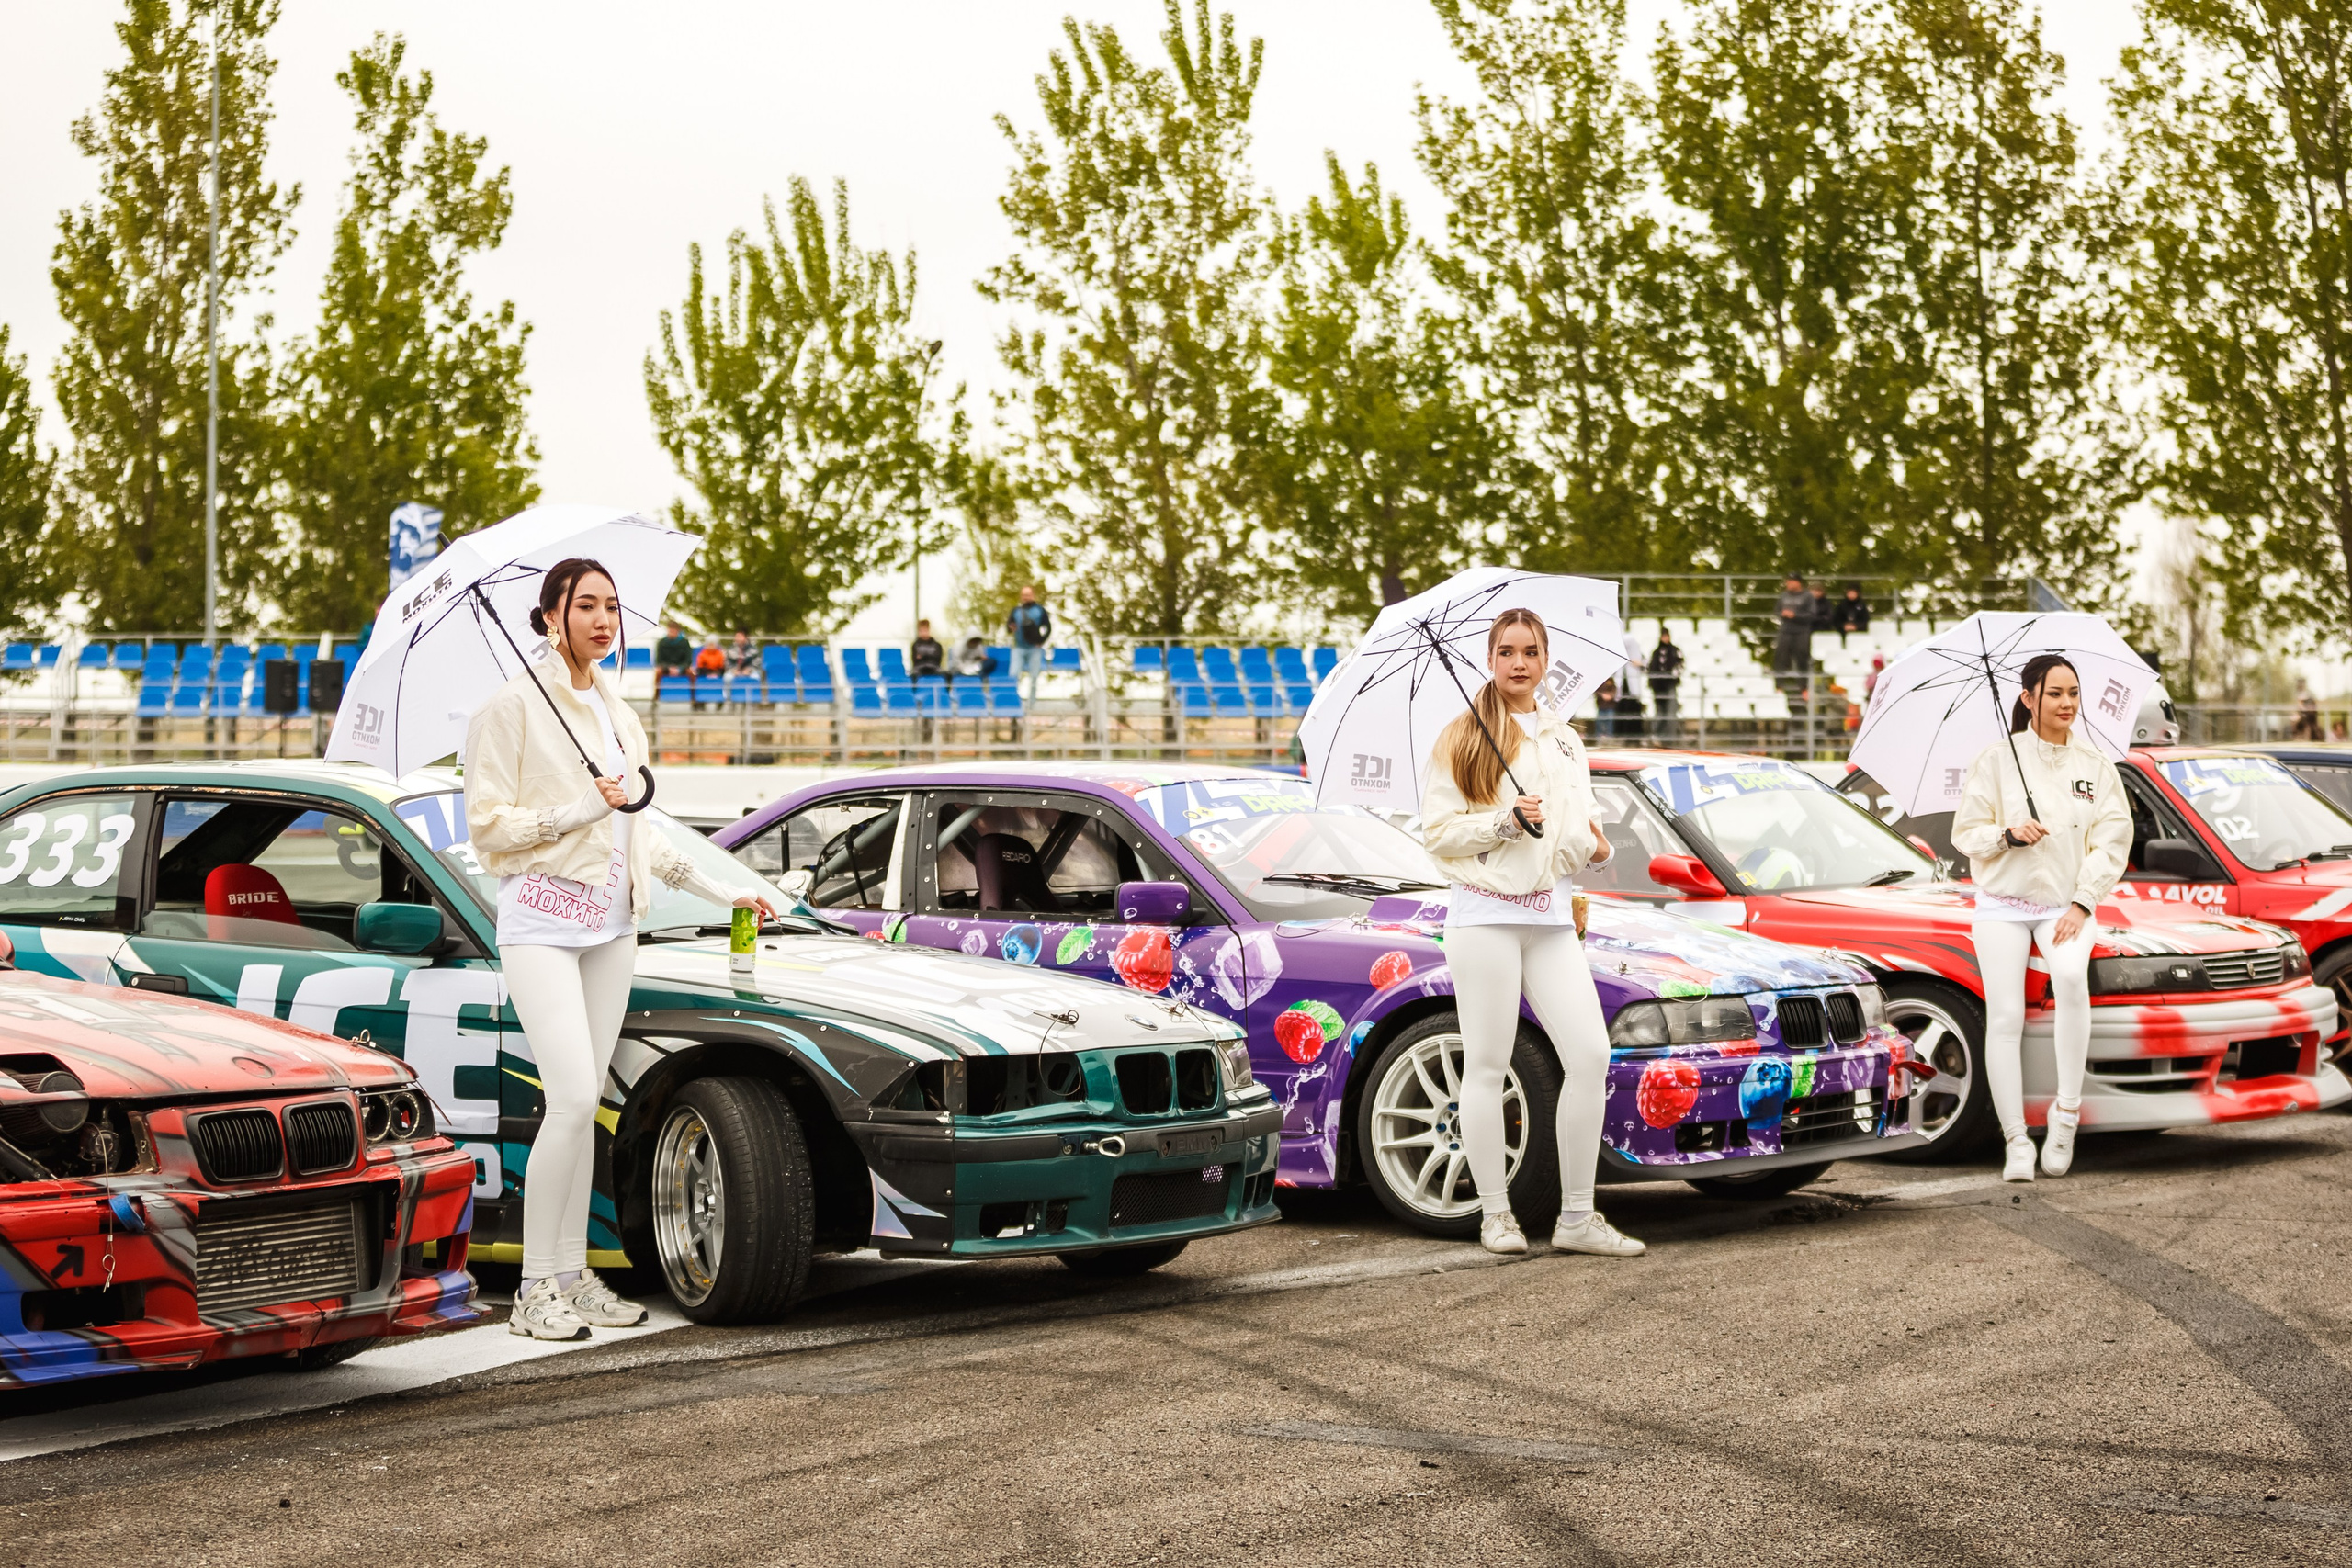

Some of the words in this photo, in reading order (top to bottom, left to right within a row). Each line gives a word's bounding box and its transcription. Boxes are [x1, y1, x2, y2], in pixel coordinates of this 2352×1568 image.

[402, 568, 452, 617] ICE
[2071, 780, 2093, 798] ICE
[1189, 824, 1245, 855] 81
[2214, 815, 2260, 841] 02
[0, 812, 135, 888] 333
[228, 892, 279, 905] BRIDE
[517, 883, 606, 932] МОХИТО
